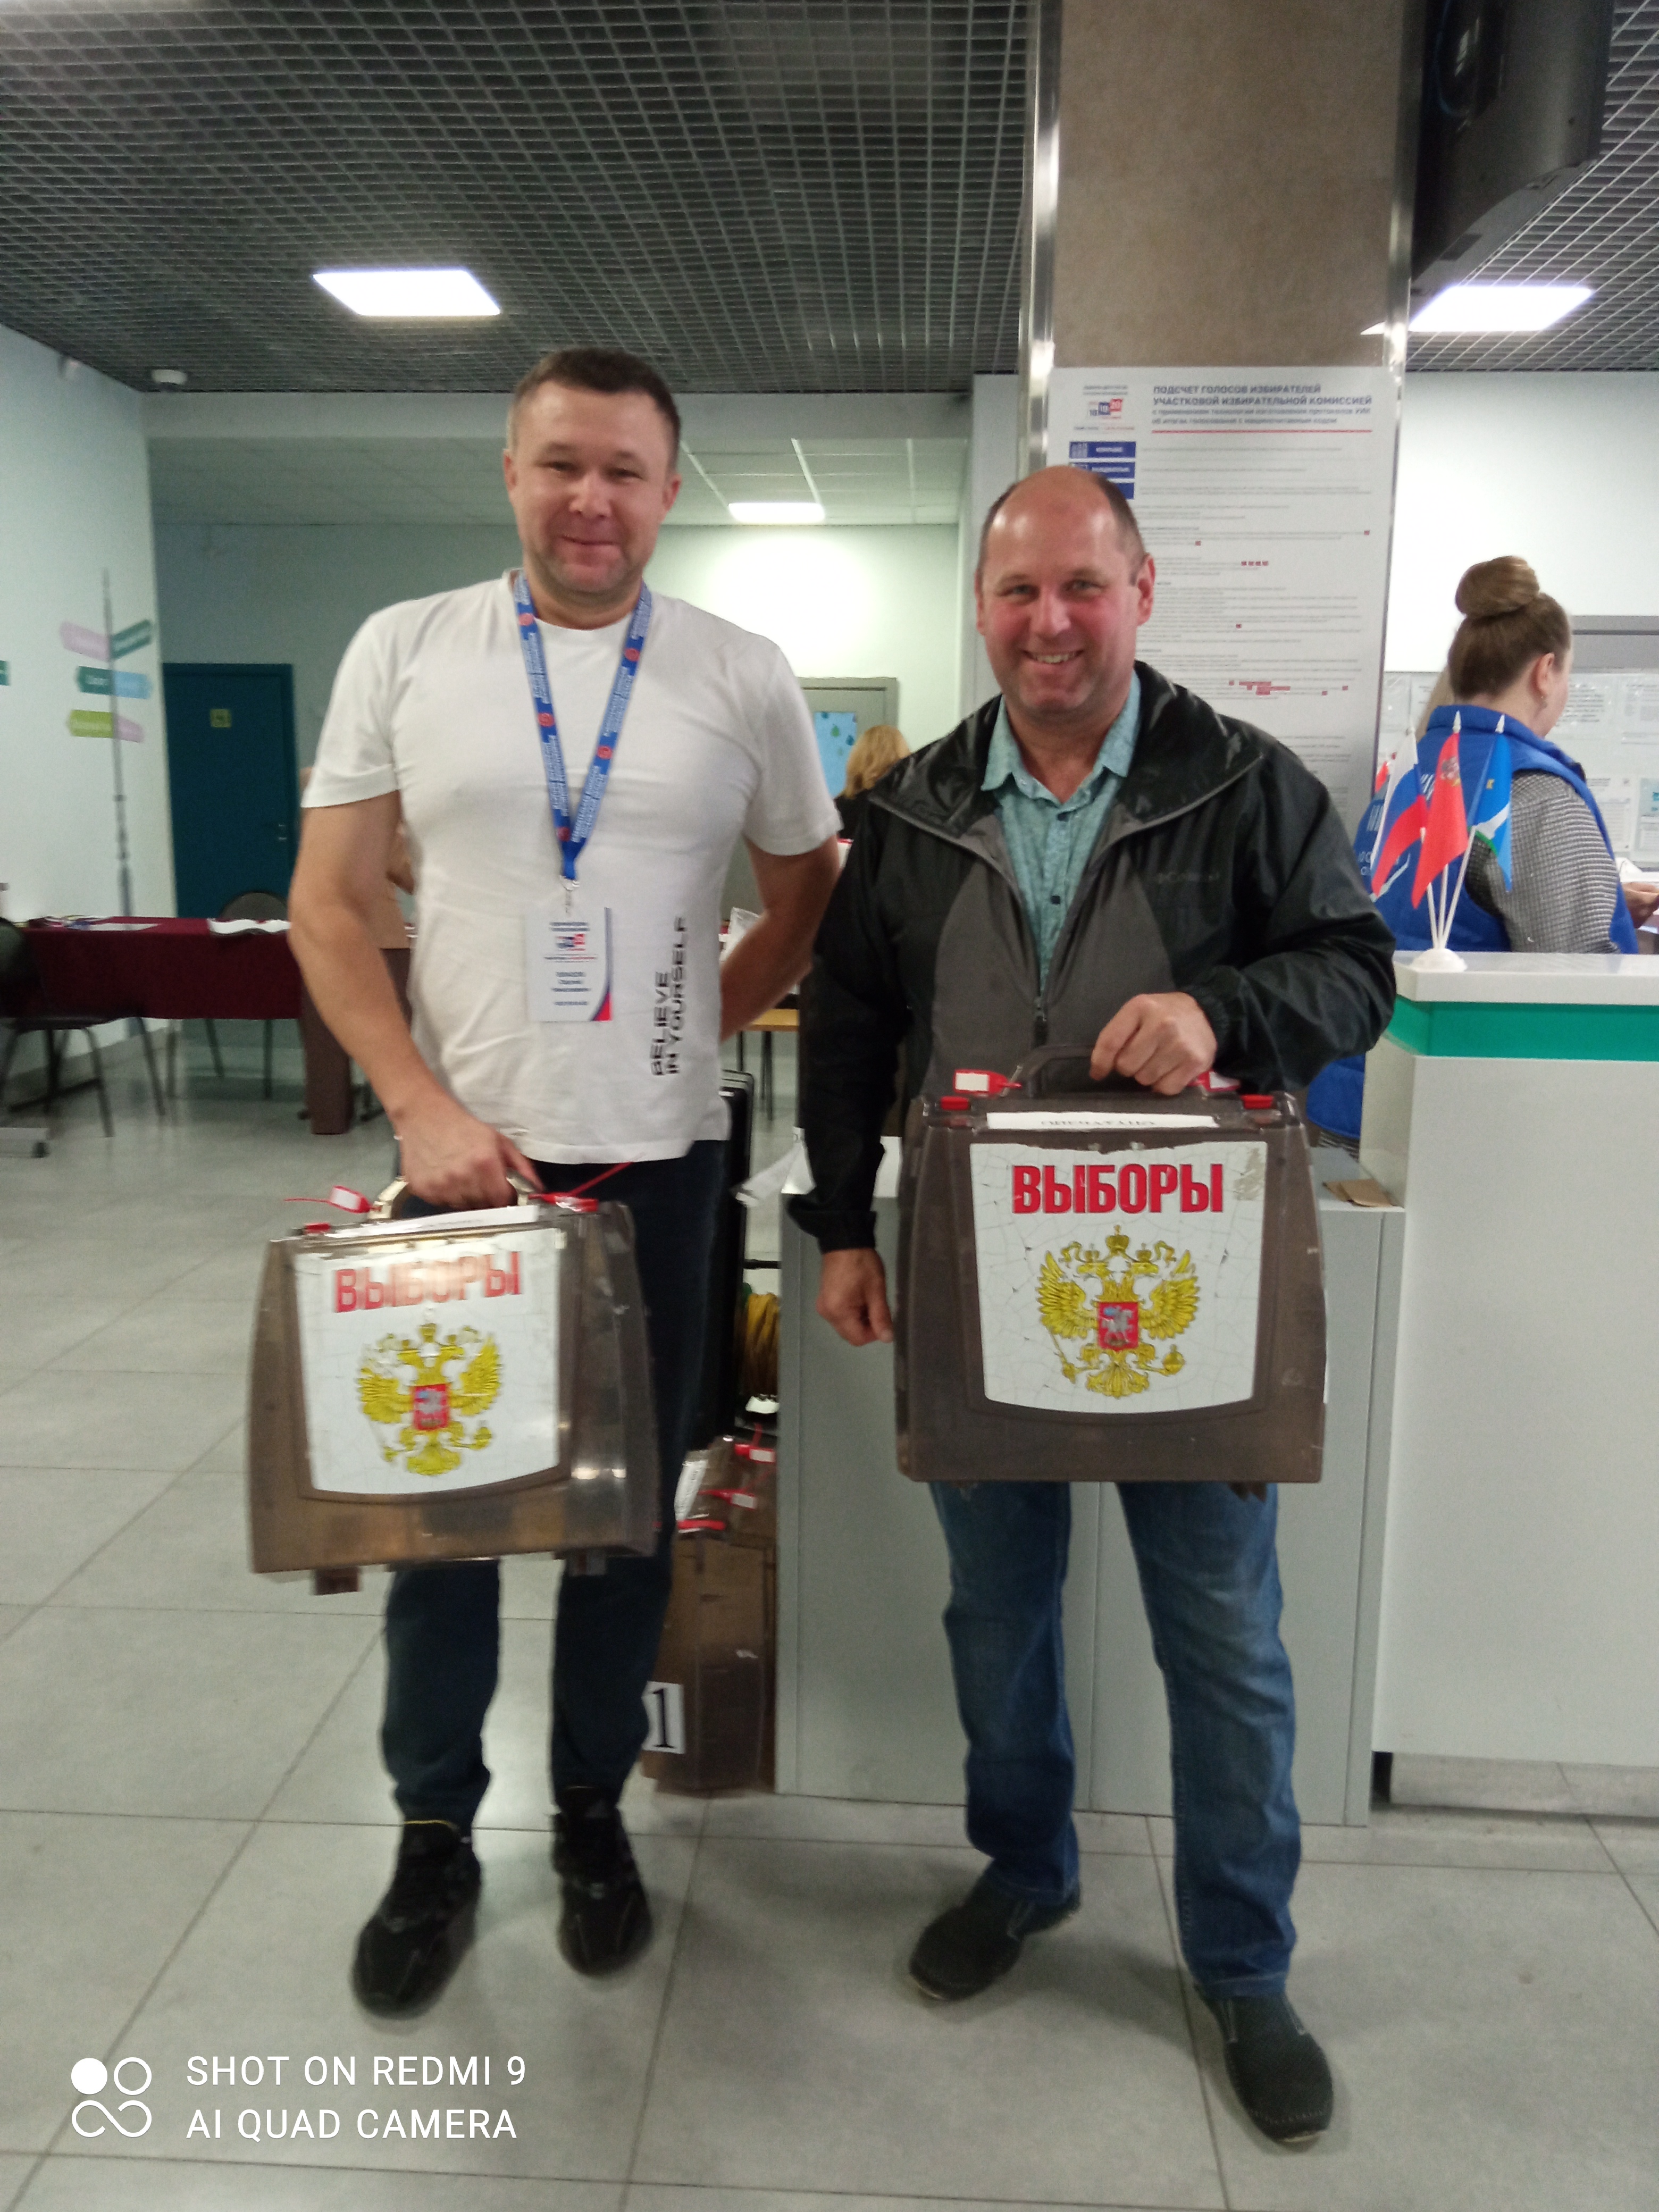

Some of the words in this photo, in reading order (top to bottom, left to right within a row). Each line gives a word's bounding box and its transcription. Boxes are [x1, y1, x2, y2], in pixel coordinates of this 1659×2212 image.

[1153, 386, 1199, 395] ПОДСЧЕТ
[1201, 385, 1248, 394] ГОЛОСОВ
[1250, 383, 1321, 393] ИЗБИРАТЕЛЕЙ
[1153, 396, 1219, 405] УЧАСТКОВОЙ
[1221, 395, 1307, 405] ИЗБИРАТЕЛЬНОЙ
[1310, 394, 1372, 405] КОМИССИЕЙ
[668, 916, 688, 1045] YOURSELF
[650, 971, 669, 1076] BELIEVE
[665, 1052, 680, 1075] IN
[1012, 1164, 1223, 1214] ВЫБОРЫ
[334, 1251, 522, 1313] ВЫБОРЫ
[652, 1688, 677, 1748] 1
